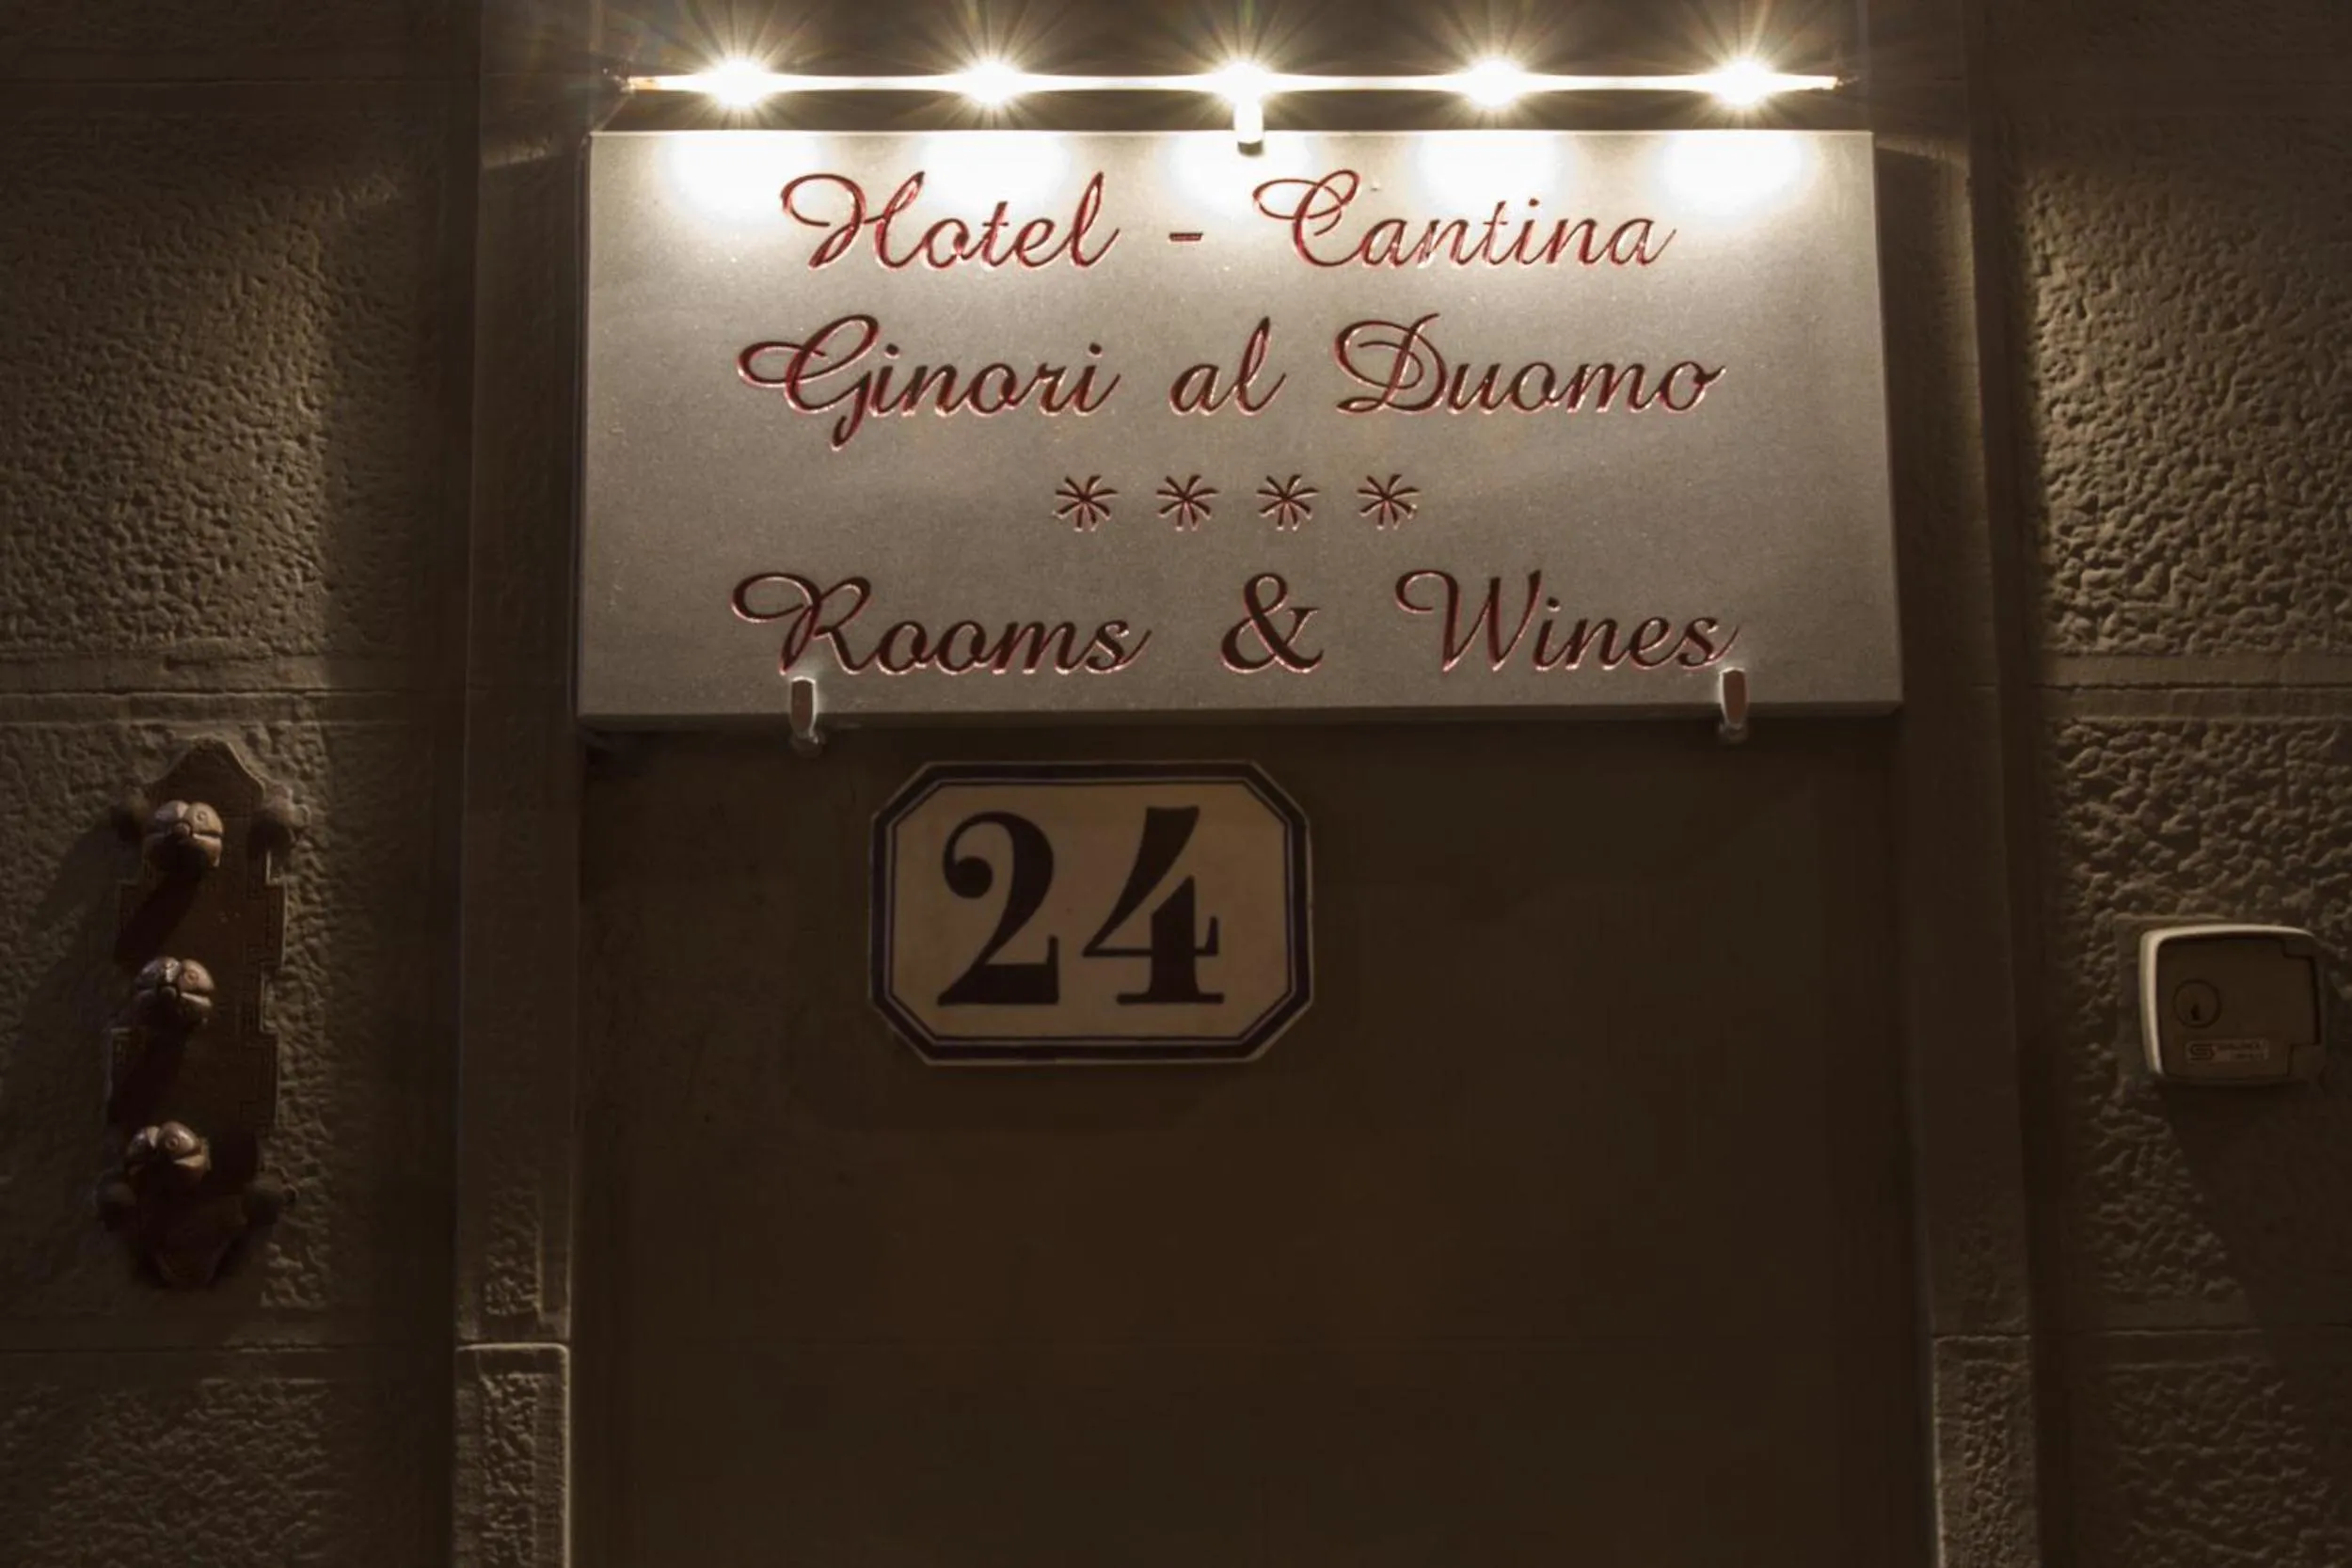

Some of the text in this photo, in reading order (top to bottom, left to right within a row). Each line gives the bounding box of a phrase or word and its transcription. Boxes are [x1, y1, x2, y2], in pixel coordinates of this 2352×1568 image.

[780, 170, 1120, 270] Hotel
[1250, 167, 1678, 270] Cantina
[736, 312, 1727, 451] Ginori al Duomo
[730, 568, 1740, 676] Rooms & Wines
[936, 804, 1226, 1006] 24
